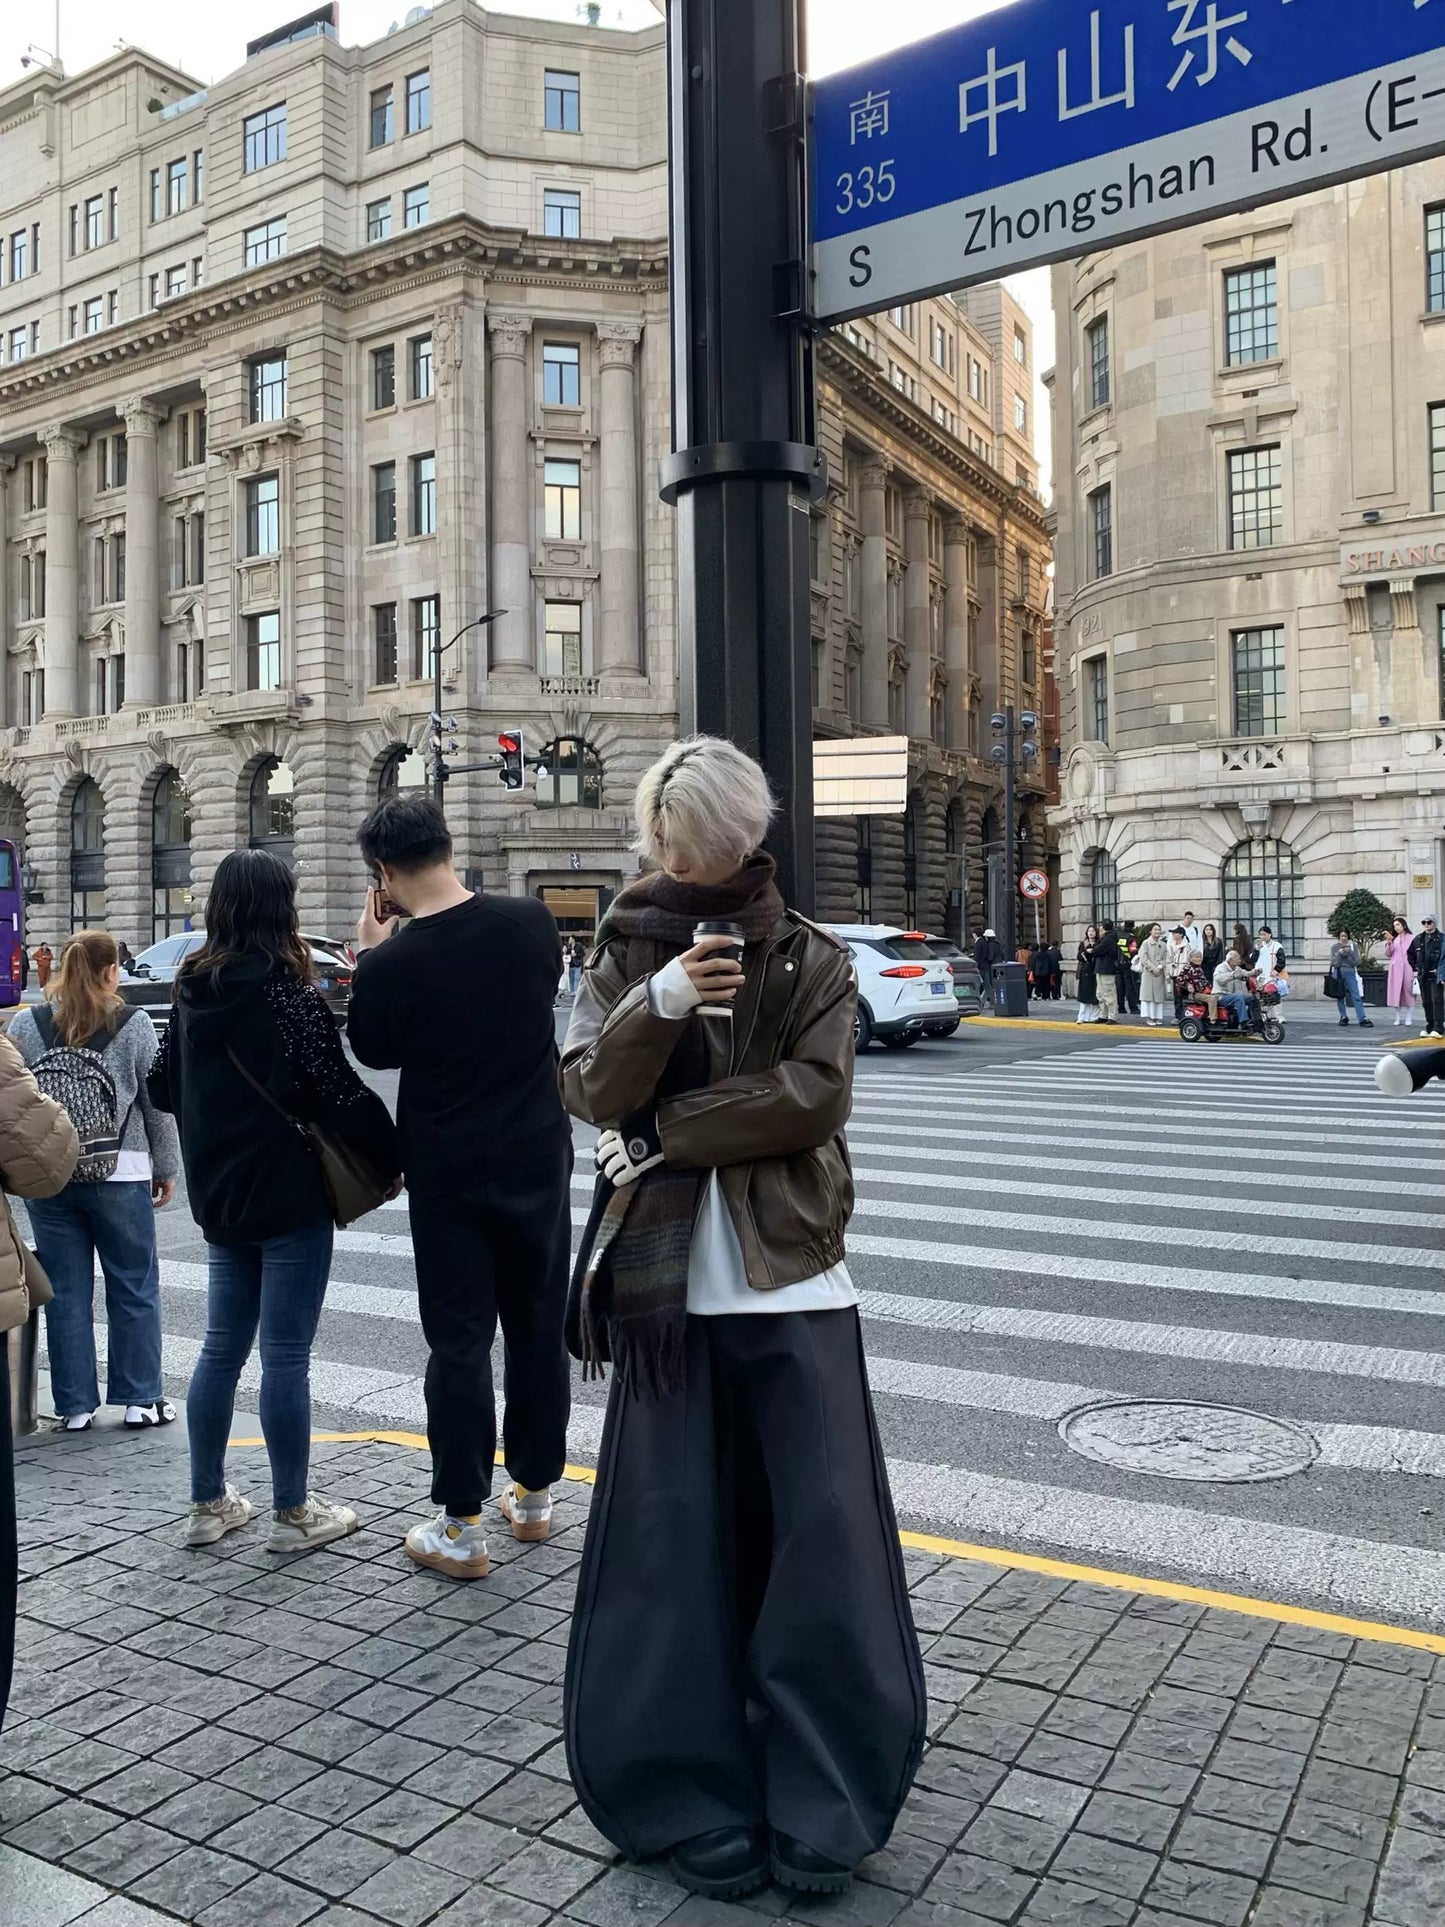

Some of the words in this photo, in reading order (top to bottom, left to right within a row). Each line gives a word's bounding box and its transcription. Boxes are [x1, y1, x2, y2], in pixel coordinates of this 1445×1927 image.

[957, 0, 1430, 157] 中山东
[849, 89, 892, 145] 南
[836, 159, 896, 214] 335
[964, 155, 1215, 256] Zhongshan
[1251, 108, 1329, 173] Rd.
[849, 244, 873, 288] S
